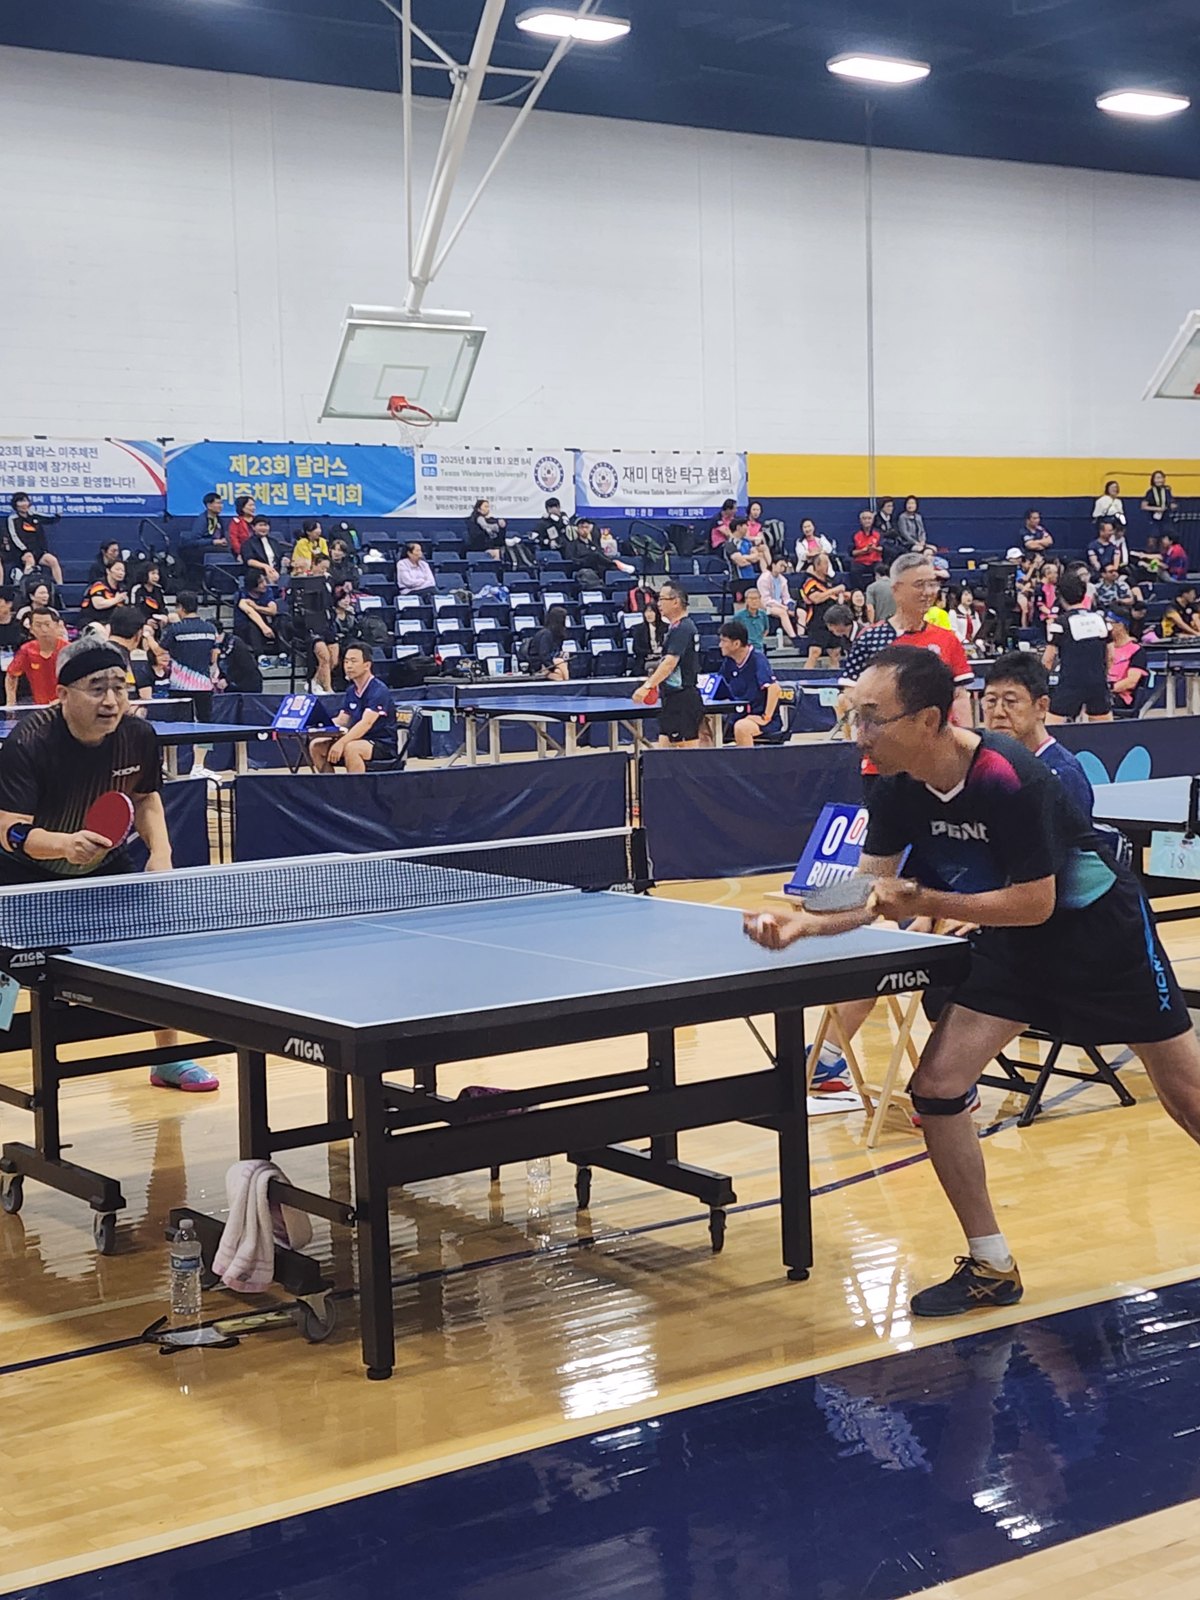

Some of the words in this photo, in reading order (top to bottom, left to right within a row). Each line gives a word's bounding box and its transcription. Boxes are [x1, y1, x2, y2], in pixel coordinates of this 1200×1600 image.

[25, 446, 56, 458] 달라스
[58, 447, 99, 459] 미주체전
[440, 456, 464, 465] 2025년
[50, 462, 91, 473] 참가하신
[229, 454, 290, 478] 제23회
[295, 455, 349, 478] 달라스
[39, 476, 81, 488] 진심으로
[82, 476, 136, 488] 환영합니다!
[622, 466, 648, 484] 재미
[652, 467, 677, 484] 대한
[680, 467, 704, 485] 탁구
[707, 466, 732, 484] 협회
[292, 482, 363, 506] 탁구대회
[282, 698, 293, 714] 2
[300, 699, 310, 715] 3
[822, 816, 848, 855] 0
[10, 951, 46, 963] STIGA
[877, 970, 930, 991] STIGA
[284, 1037, 325, 1062] STIGA
